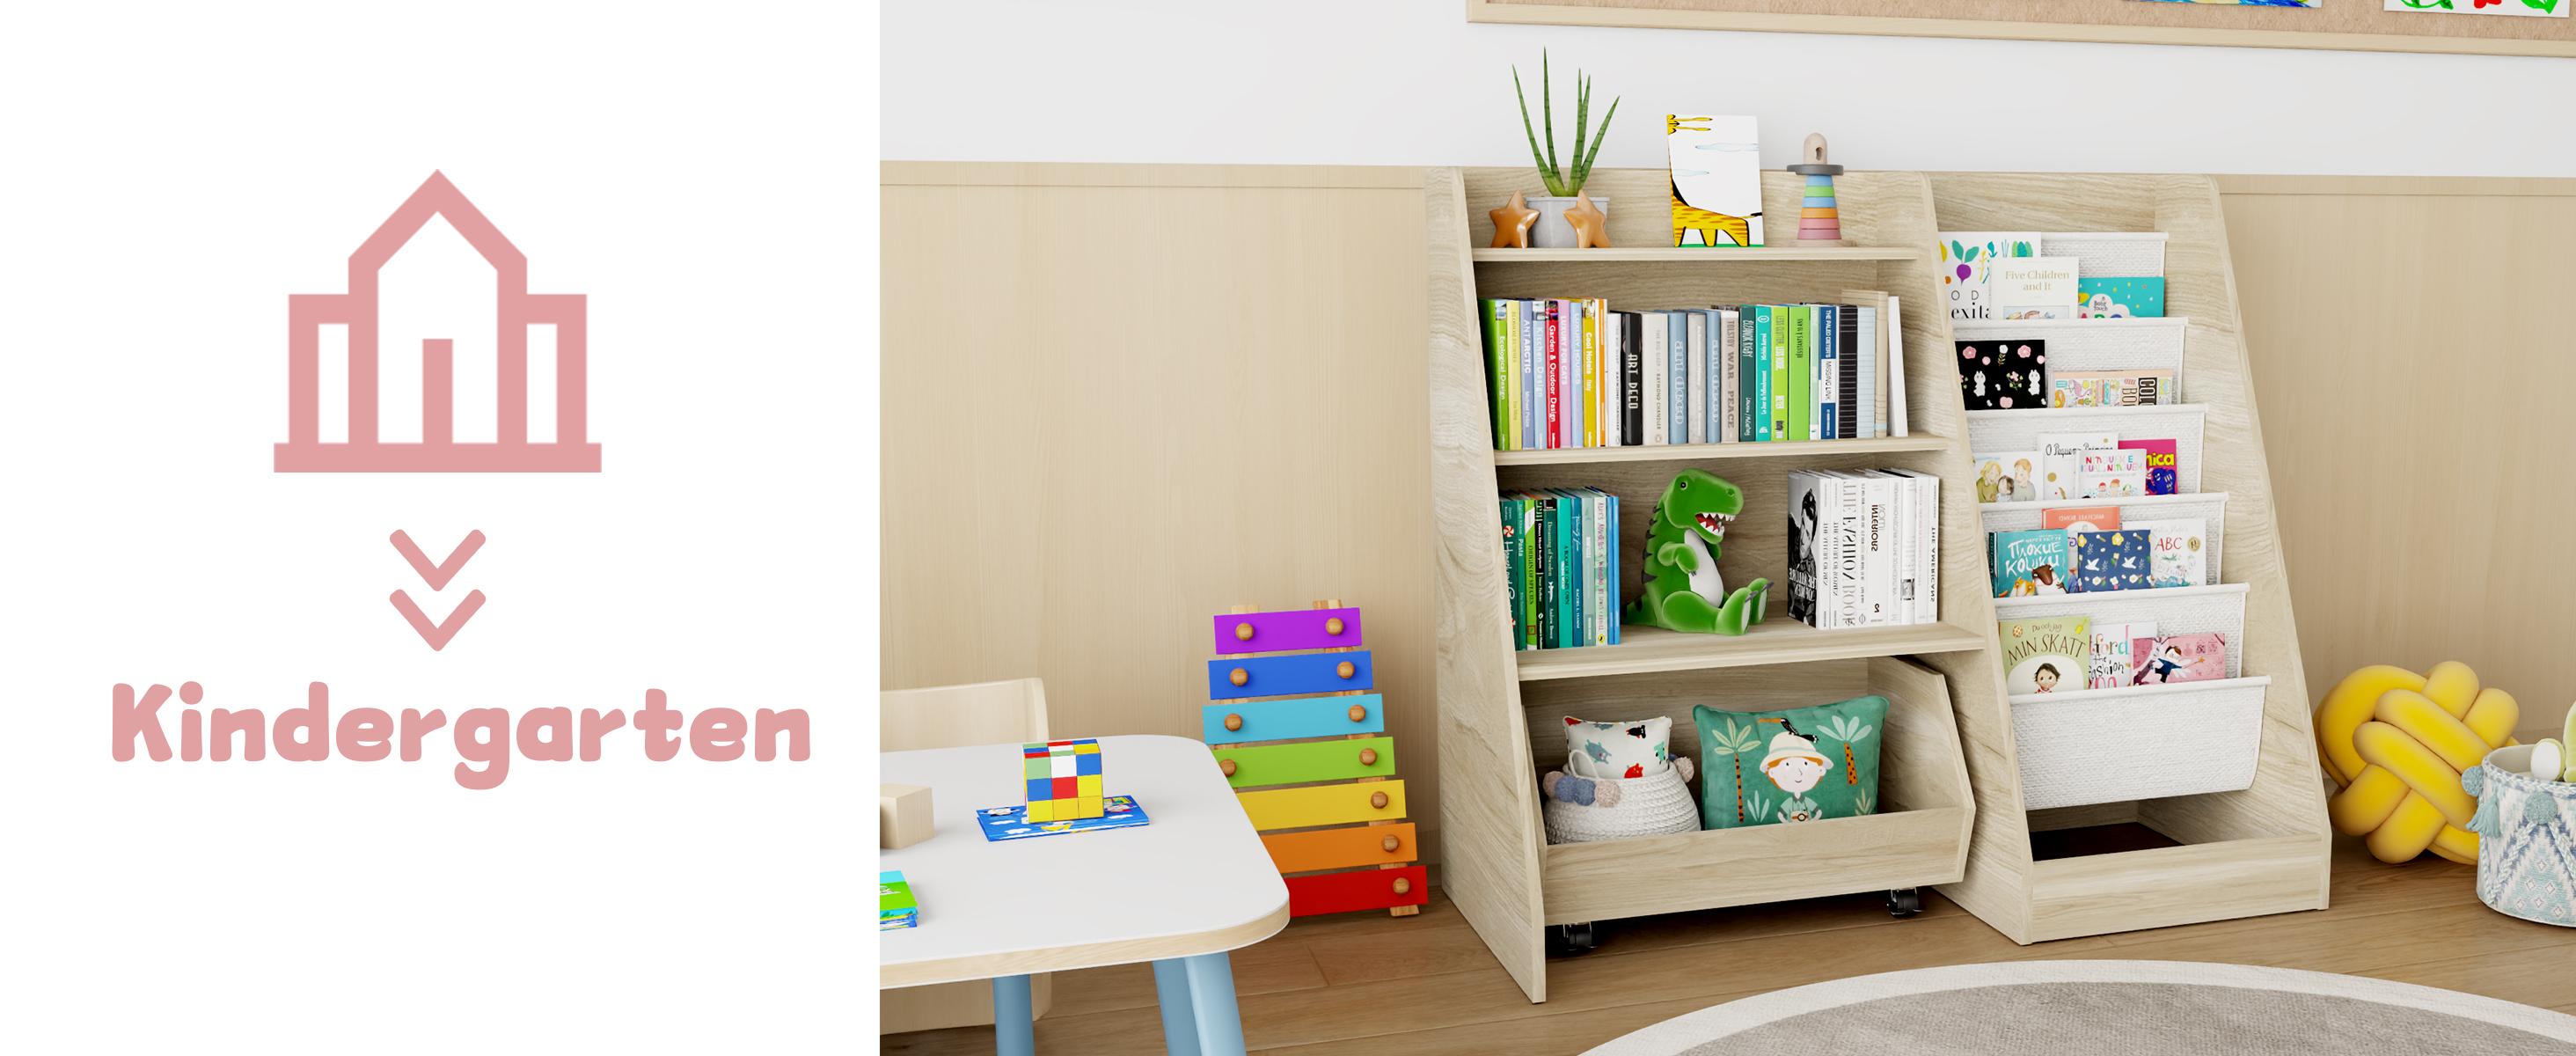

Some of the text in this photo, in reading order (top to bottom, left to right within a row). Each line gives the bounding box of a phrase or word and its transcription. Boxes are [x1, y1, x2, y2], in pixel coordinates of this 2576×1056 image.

[2006, 270, 2069, 280] Five Children
[2023, 282, 2041, 290] and
[1743, 320, 1753, 341] ELEANOR
[1743, 342, 1753, 357] RIGBY
[1628, 354, 1638, 409] ART DECO
[2008, 539, 2063, 559] ПЛОХИЕ
[2155, 537, 2182, 551] ABC
[1528, 569, 1533, 578] OF
[2008, 634, 2087, 665] MIN SKATT
